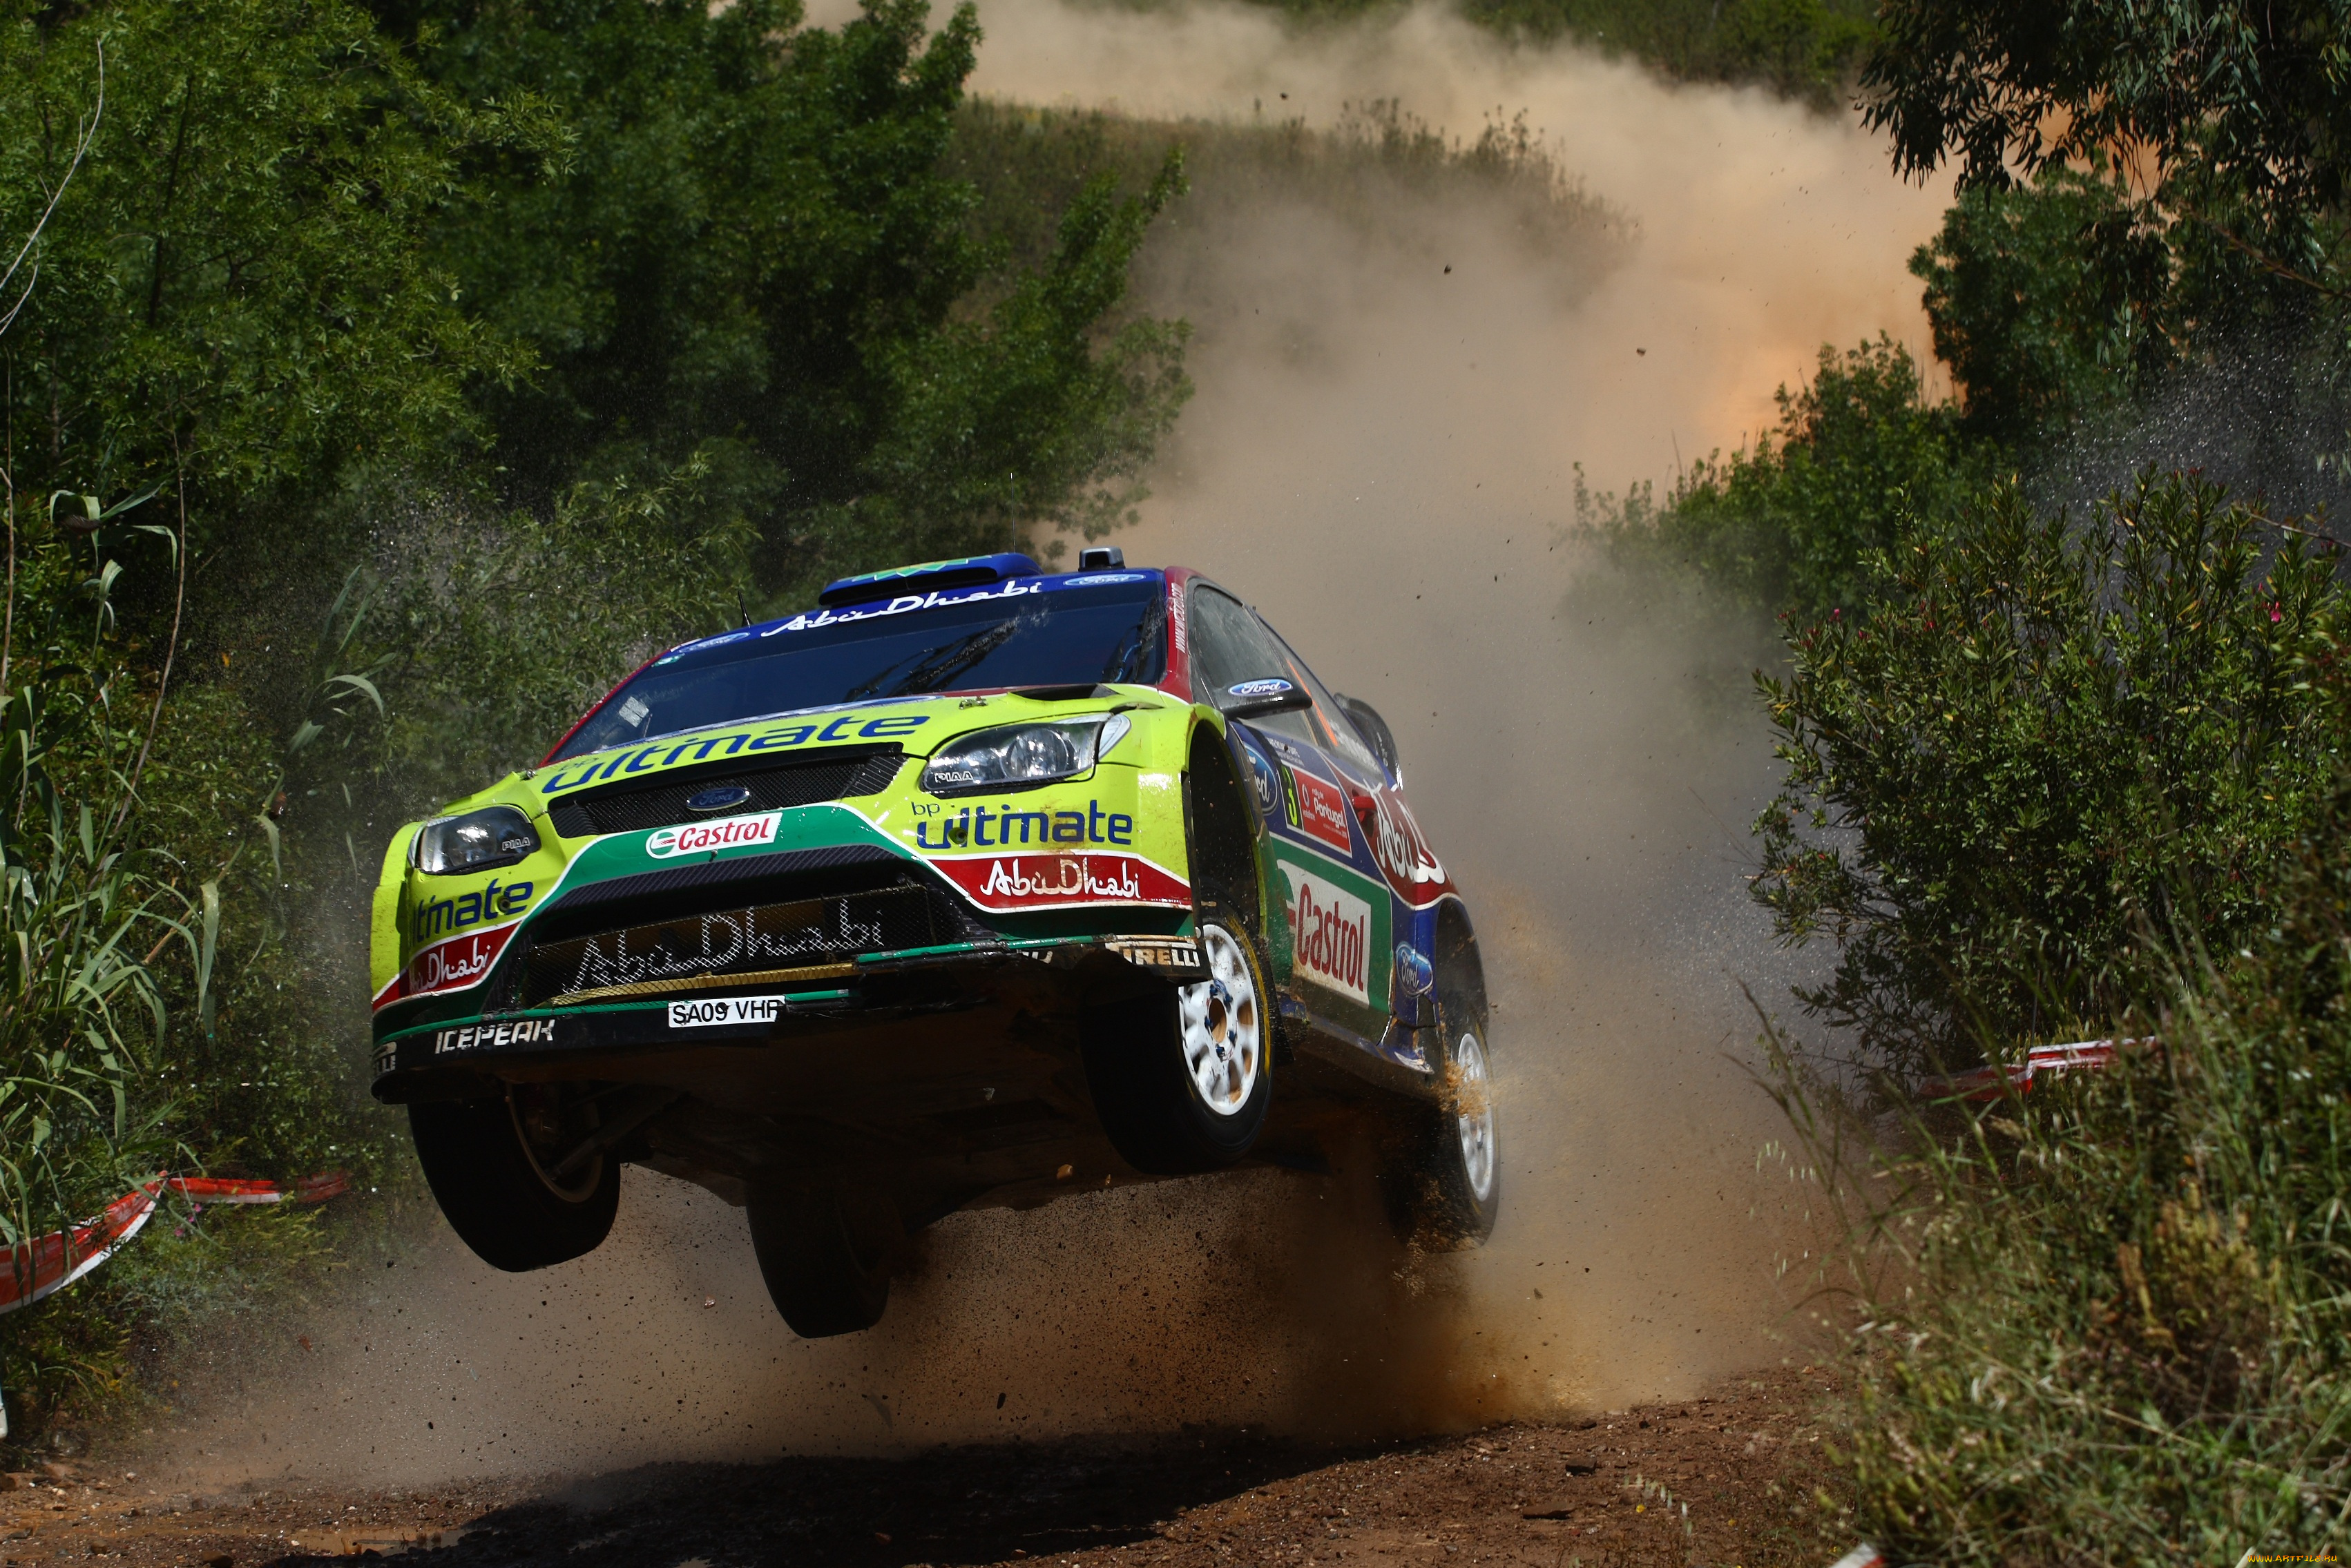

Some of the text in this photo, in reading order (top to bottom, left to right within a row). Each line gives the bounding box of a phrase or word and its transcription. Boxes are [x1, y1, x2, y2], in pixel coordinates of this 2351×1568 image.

[1241, 680, 1281, 695] Ford
[541, 715, 930, 794] ultimate
[934, 771, 974, 783] PIAA
[698, 789, 736, 806] Ford
[911, 801, 940, 817] bp
[1313, 796, 1346, 829] Portugal
[678, 817, 771, 851] Castrol
[917, 799, 1133, 849] ultimate
[502, 837, 531, 851] PIAA
[416, 878, 534, 943] timate
[1296, 882, 1365, 992] Castrol
[673, 1002, 729, 1025] SA09
[434, 1018, 555, 1054] ICEPEAK
